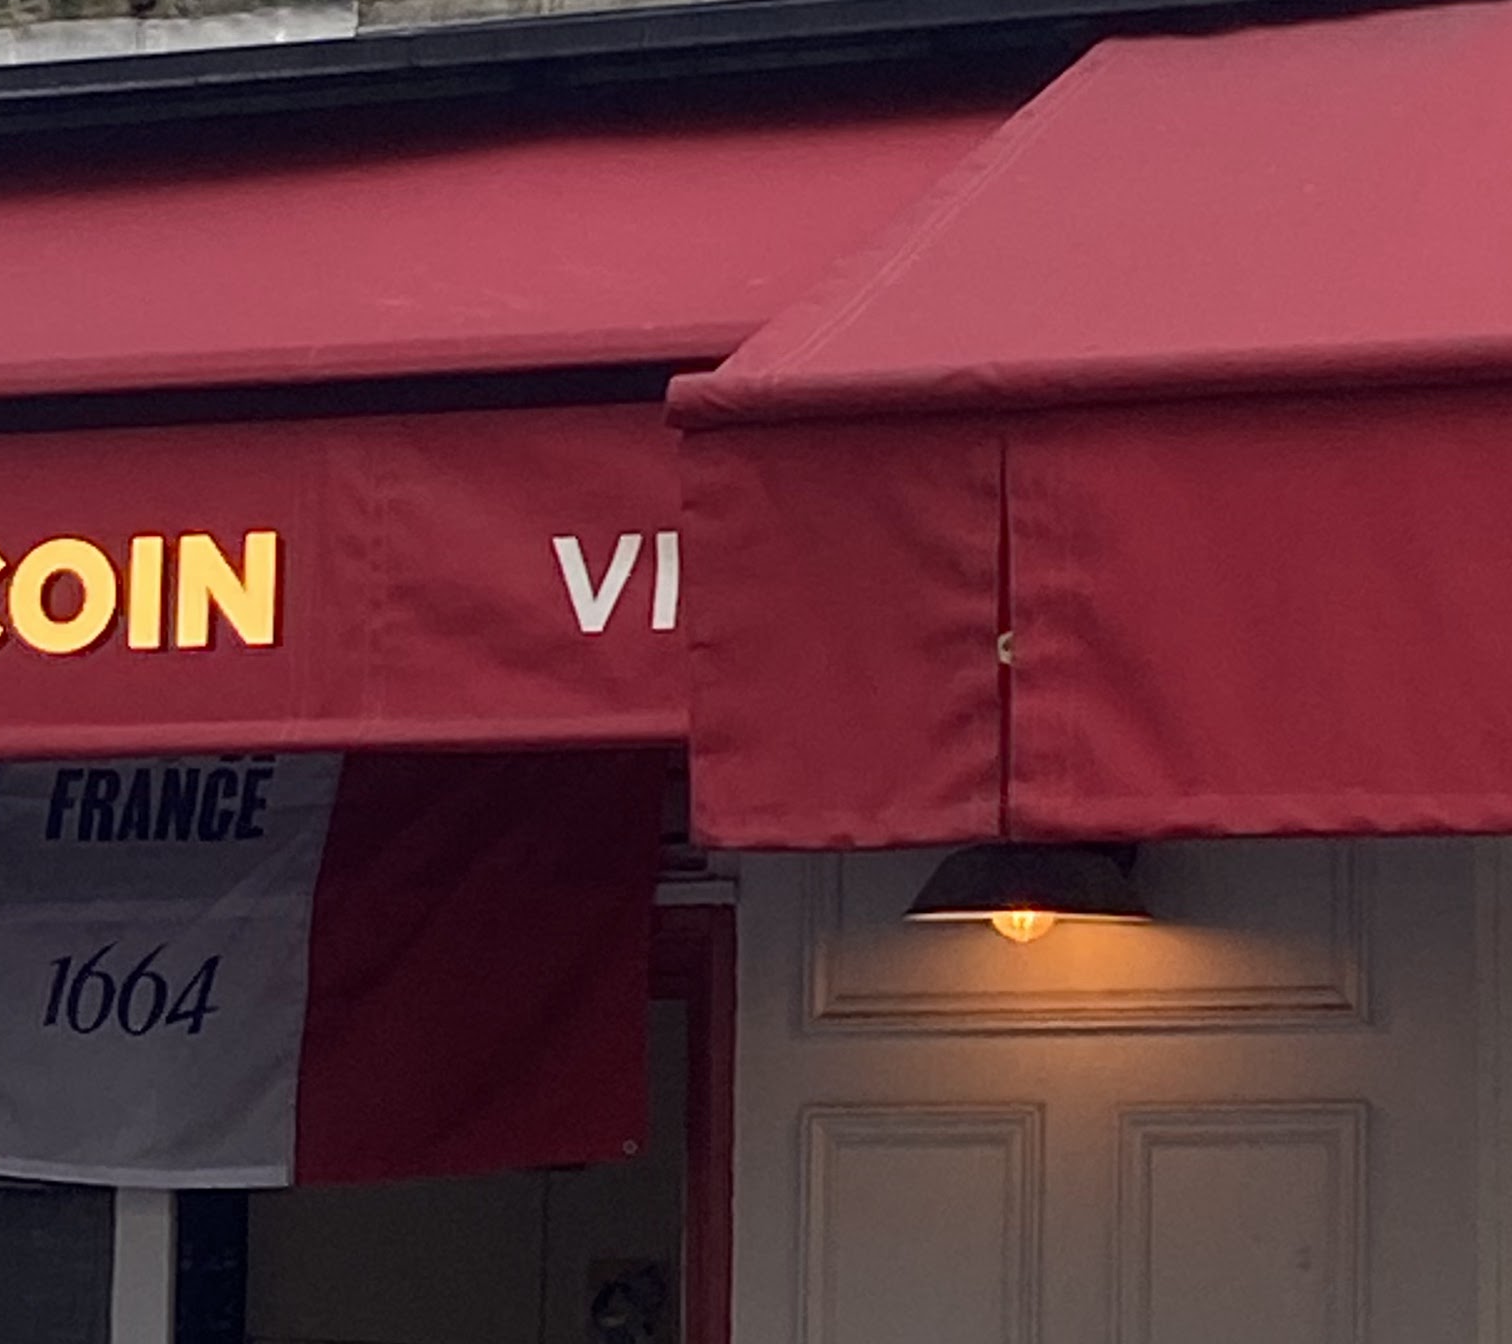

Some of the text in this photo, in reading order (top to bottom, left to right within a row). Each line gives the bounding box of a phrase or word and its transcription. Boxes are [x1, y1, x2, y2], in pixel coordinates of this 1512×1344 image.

[551, 530, 679, 634] VI
[44, 766, 275, 842] FRANCE
[42, 940, 220, 1036] 1664
